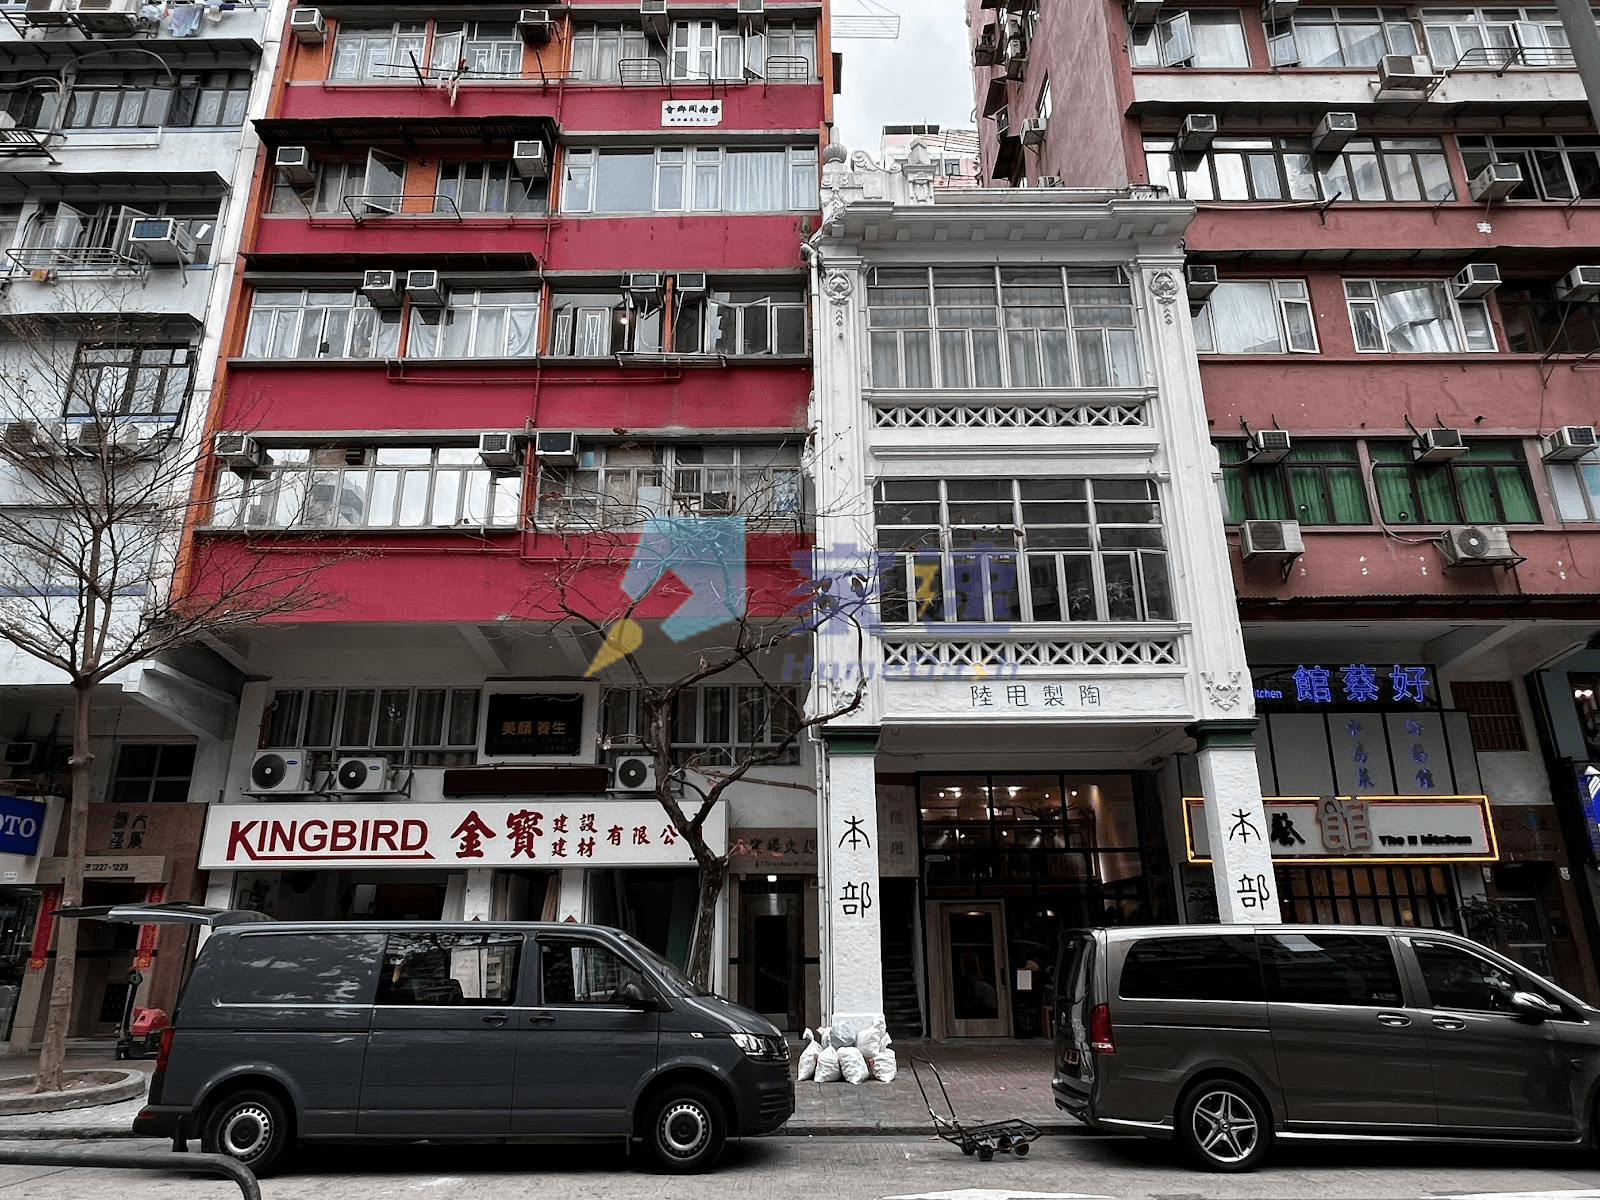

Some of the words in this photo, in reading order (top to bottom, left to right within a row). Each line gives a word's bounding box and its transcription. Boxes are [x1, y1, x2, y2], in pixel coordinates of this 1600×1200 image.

[1253, 689, 1283, 699] itchen
[0, 813, 37, 838] TO
[606, 824, 703, 847] 有限公
[226, 818, 429, 861] KINGBIRD
[551, 836, 597, 858] 建材
[838, 815, 872, 919] 本部
[1229, 808, 1270, 911] 本部
